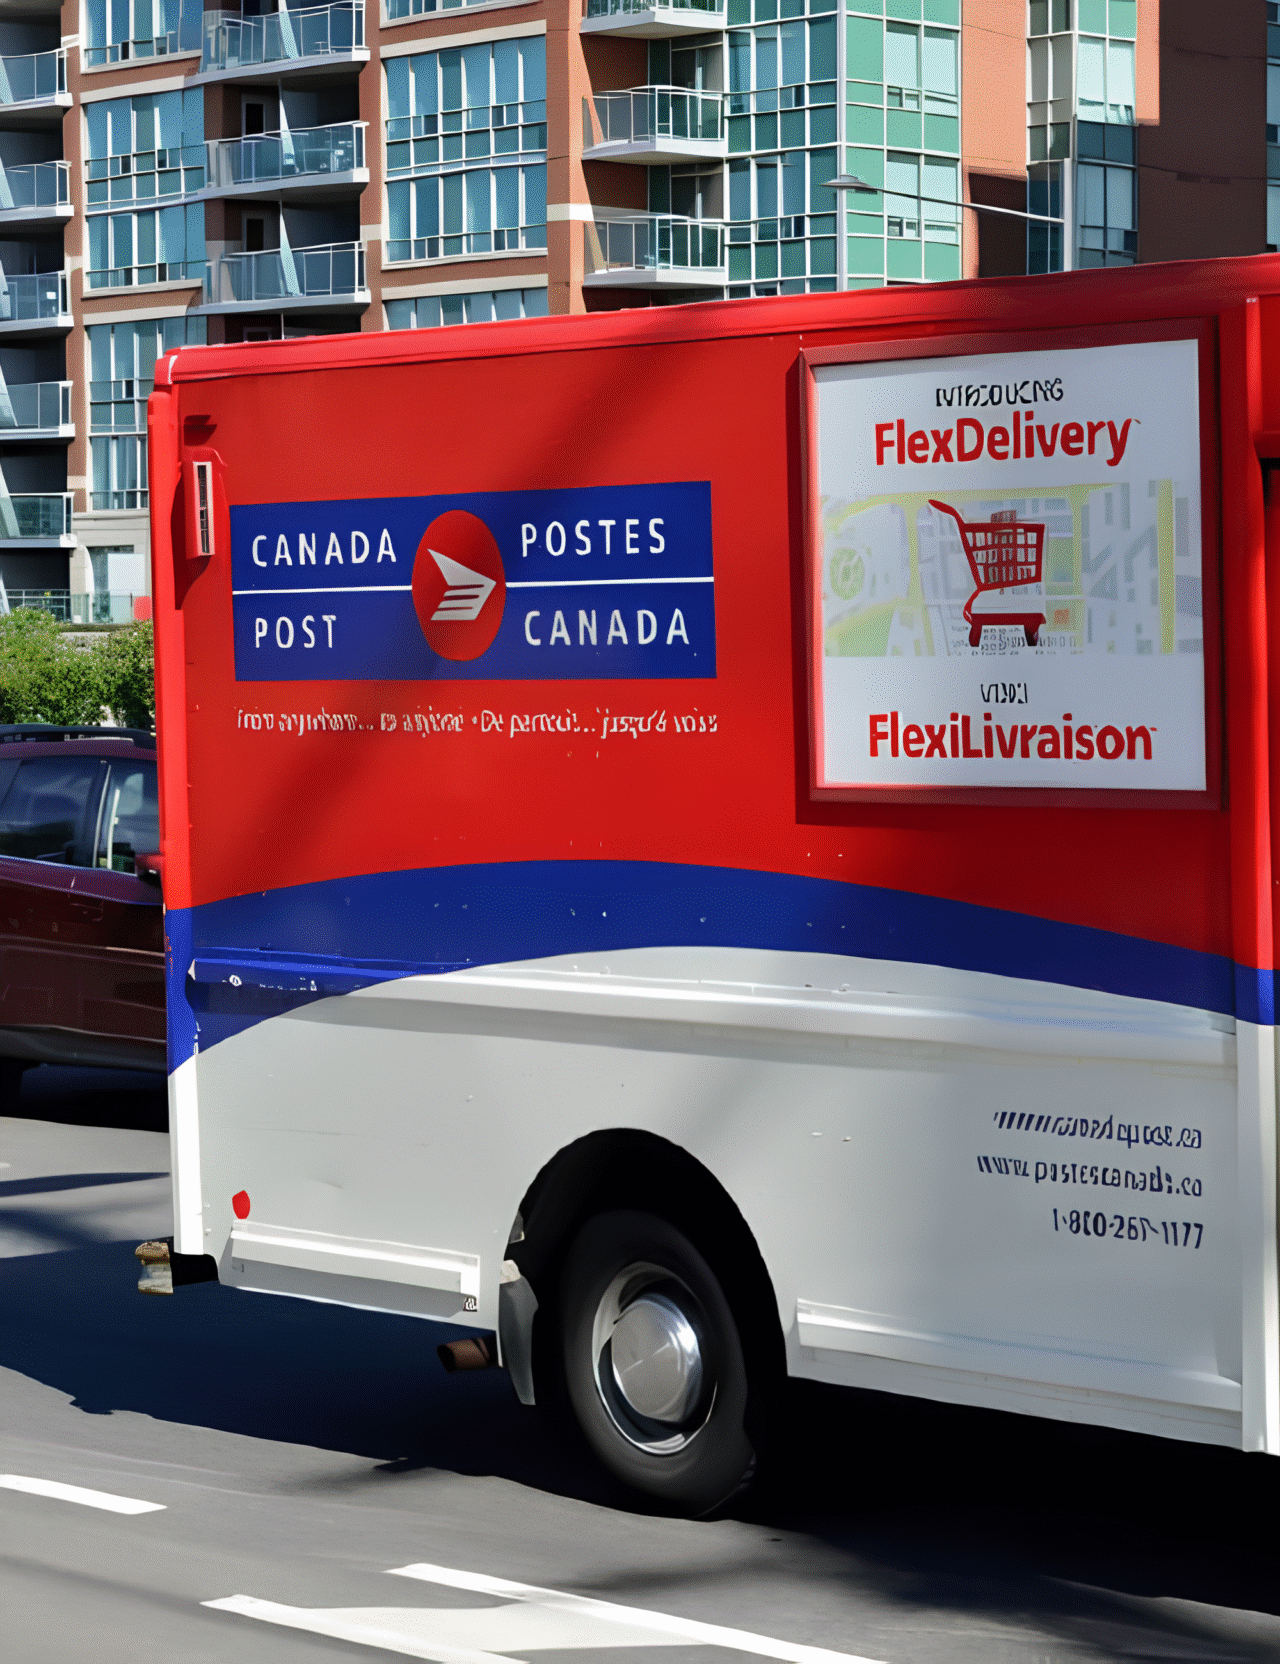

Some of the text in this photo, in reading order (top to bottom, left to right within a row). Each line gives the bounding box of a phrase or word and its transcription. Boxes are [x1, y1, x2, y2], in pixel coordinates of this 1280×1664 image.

[875, 410, 1133, 467] FlexDelivery
[252, 529, 397, 567] CANADA
[521, 518, 666, 557] POSTES
[255, 615, 337, 649] POST
[525, 608, 690, 646] CANADA
[869, 711, 1153, 760] FlexiLivraison
